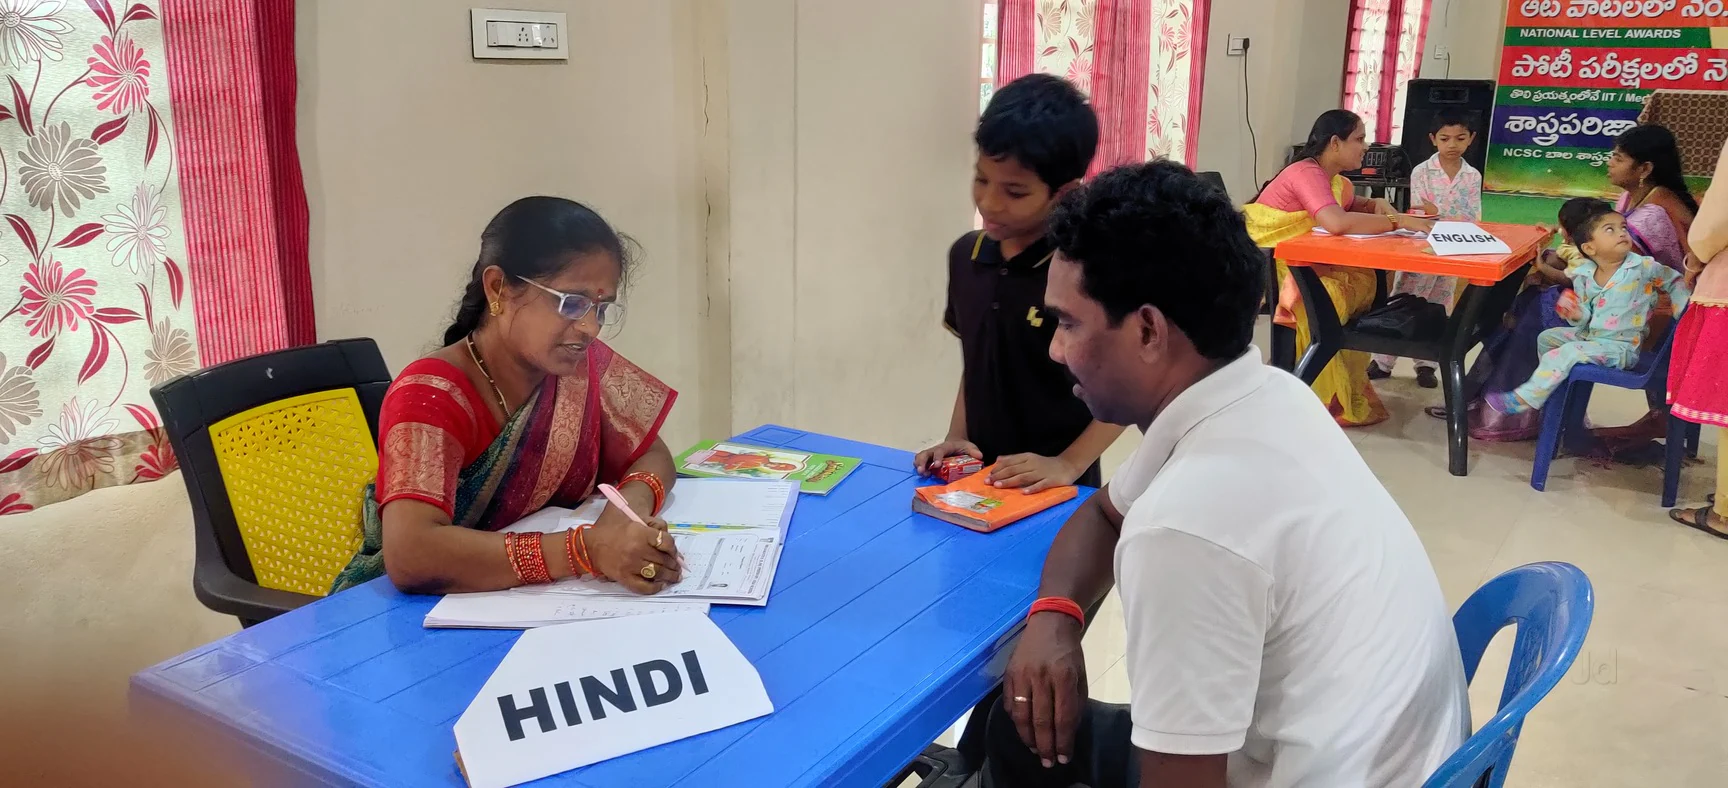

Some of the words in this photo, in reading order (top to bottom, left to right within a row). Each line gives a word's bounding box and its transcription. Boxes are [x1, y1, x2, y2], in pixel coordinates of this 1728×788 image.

[1520, 28, 1580, 38] NATIONAL
[1582, 29, 1622, 39] LEVEL
[1624, 29, 1682, 39] AWARDS
[1511, 49, 1572, 78] పోటీ
[1578, 52, 1698, 88] పరీక్షలలో
[1601, 93, 1616, 102] IIT
[1617, 93, 1624, 102] /
[1503, 148, 1542, 158] NCSC
[1545, 151, 1573, 160] బాల
[1431, 233, 1497, 243] ENGLISH
[497, 650, 709, 742] HINDI
